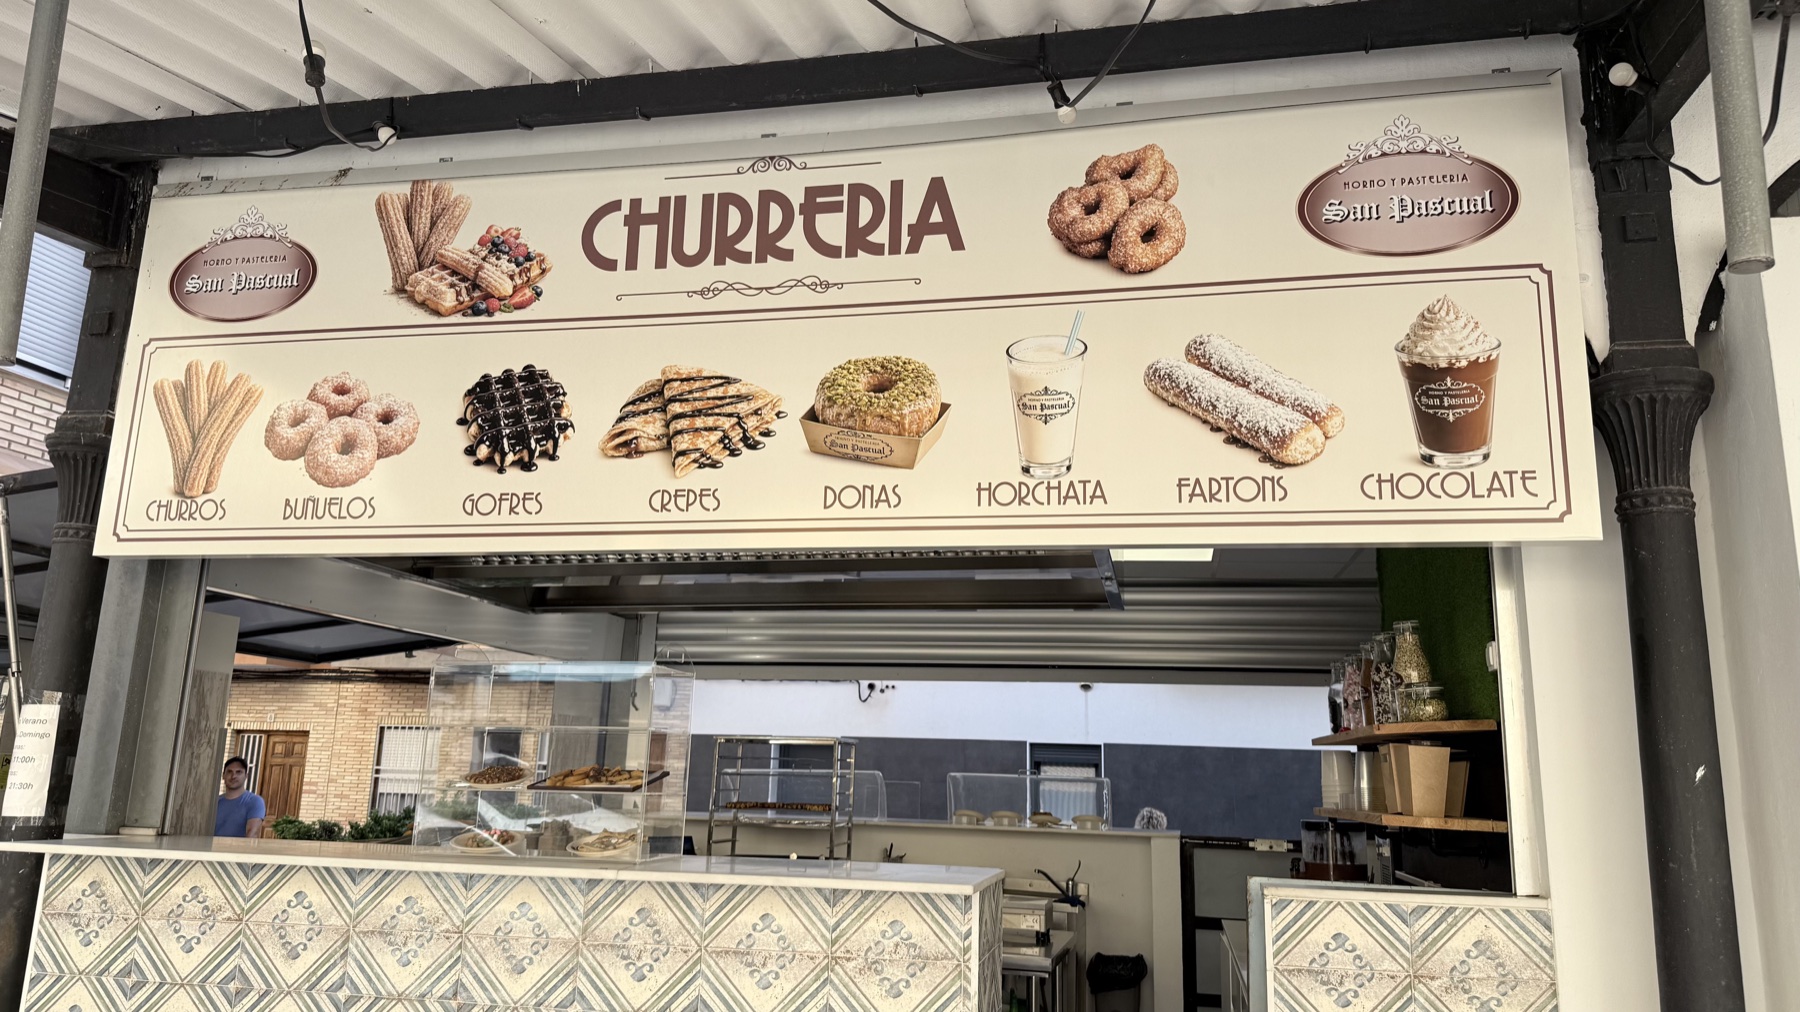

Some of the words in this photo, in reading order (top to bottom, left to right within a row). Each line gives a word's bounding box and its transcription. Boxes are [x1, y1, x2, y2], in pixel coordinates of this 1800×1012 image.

[1343, 179, 1386, 190] HORNO
[1390, 178, 1396, 187] Y
[1401, 173, 1470, 186] PASTELERIA
[1322, 198, 1381, 224] San
[1388, 189, 1496, 223] Pascual
[581, 176, 966, 272] CHURRERIA
[203, 257, 232, 267] HORNO
[235, 257, 240, 265] Y
[241, 254, 288, 265] PASTELERIA
[184, 274, 224, 295] San
[228, 268, 301, 295] Pascual
[1021, 402, 1037, 411] San
[1040, 400, 1070, 412] Pascual
[1421, 395, 1440, 406] San
[1442, 394, 1479, 407] Pascual
[829, 440, 849, 450] San
[851, 443, 885, 455] Pascual
[823, 483, 902, 510] DONAS
[976, 479, 1108, 508] HORCHATA
[1176, 475, 1289, 504] FARTONS
[1360, 469, 1539, 501] CHOCOLATE
[146, 498, 227, 523] CHURROS
[283, 495, 376, 521] BUÑUELOS
[462, 492, 543, 517] GOFRES
[648, 487, 721, 513] CREPES
[21, 717, 48, 725] Verano
